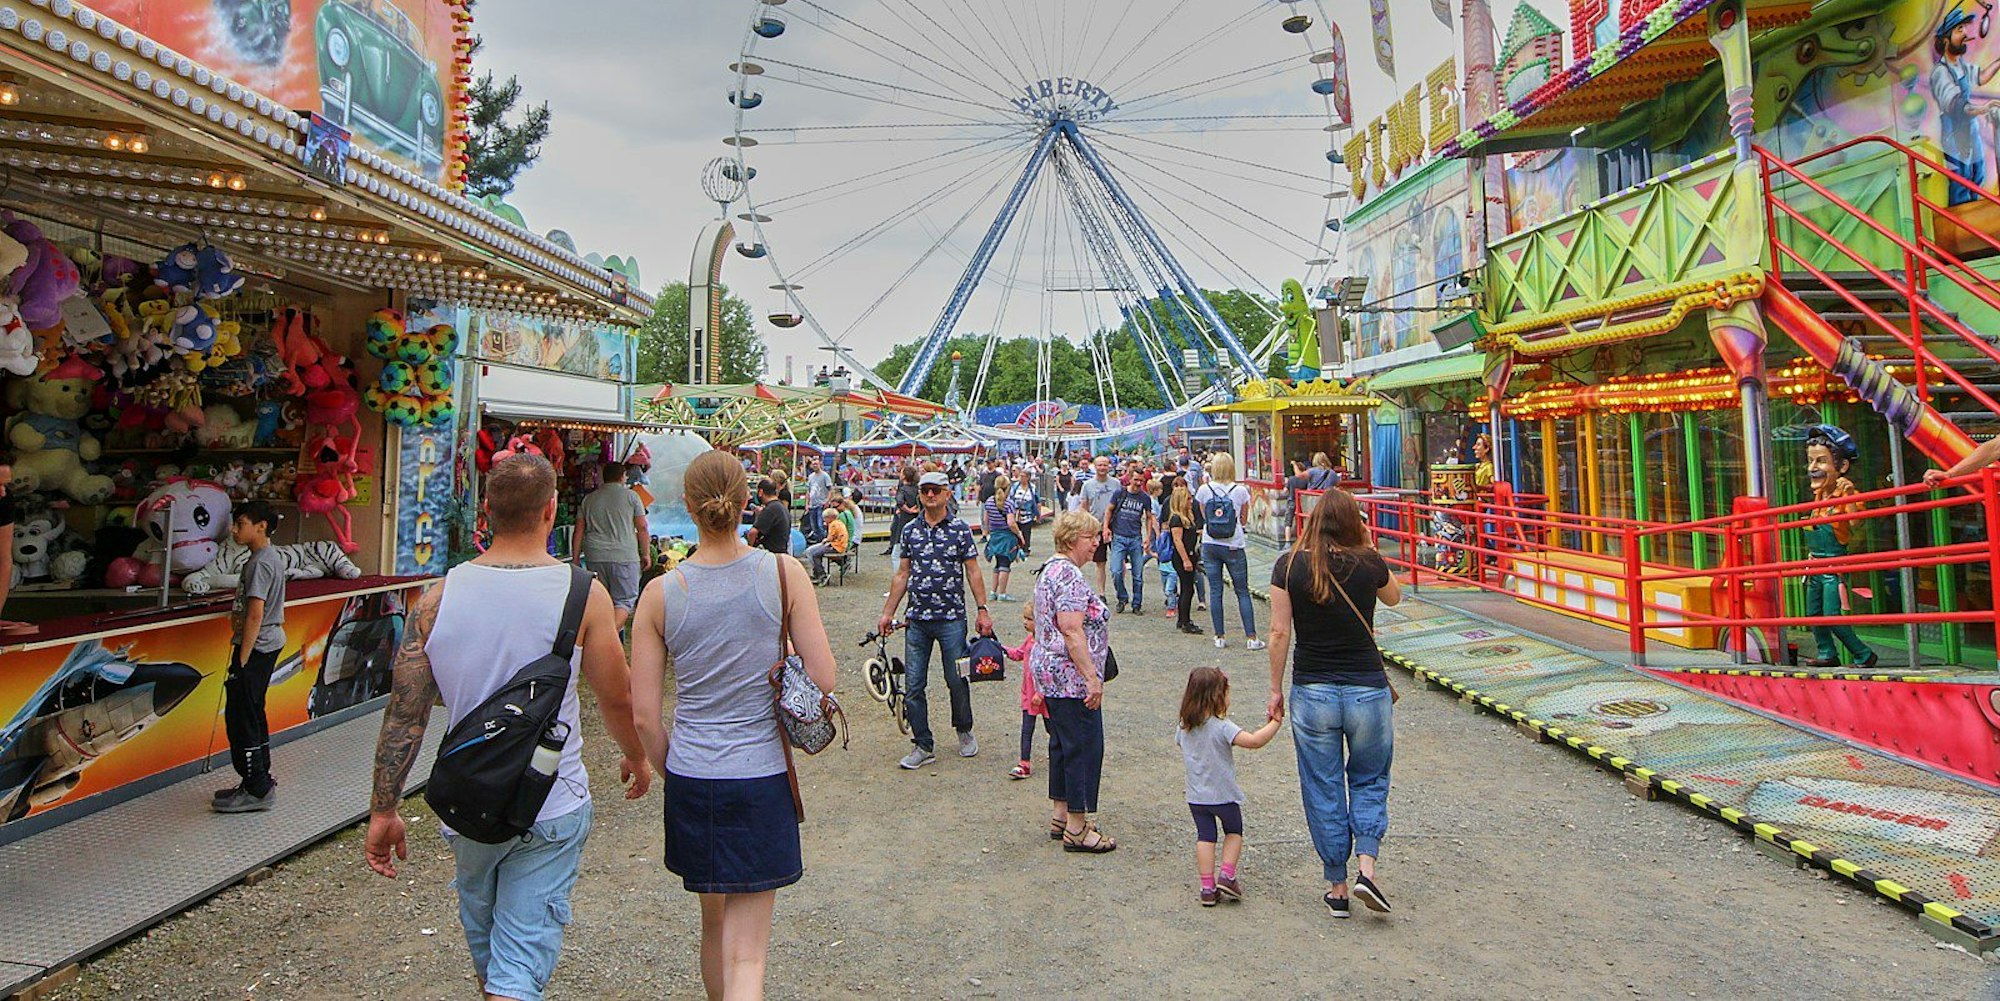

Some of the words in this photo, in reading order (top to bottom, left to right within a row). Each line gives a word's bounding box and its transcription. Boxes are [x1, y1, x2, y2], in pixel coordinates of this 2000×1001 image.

[1010, 76, 1120, 117] LIBERTY
[1343, 54, 1460, 205] TIME
[1796, 795, 1951, 831] DANGER
